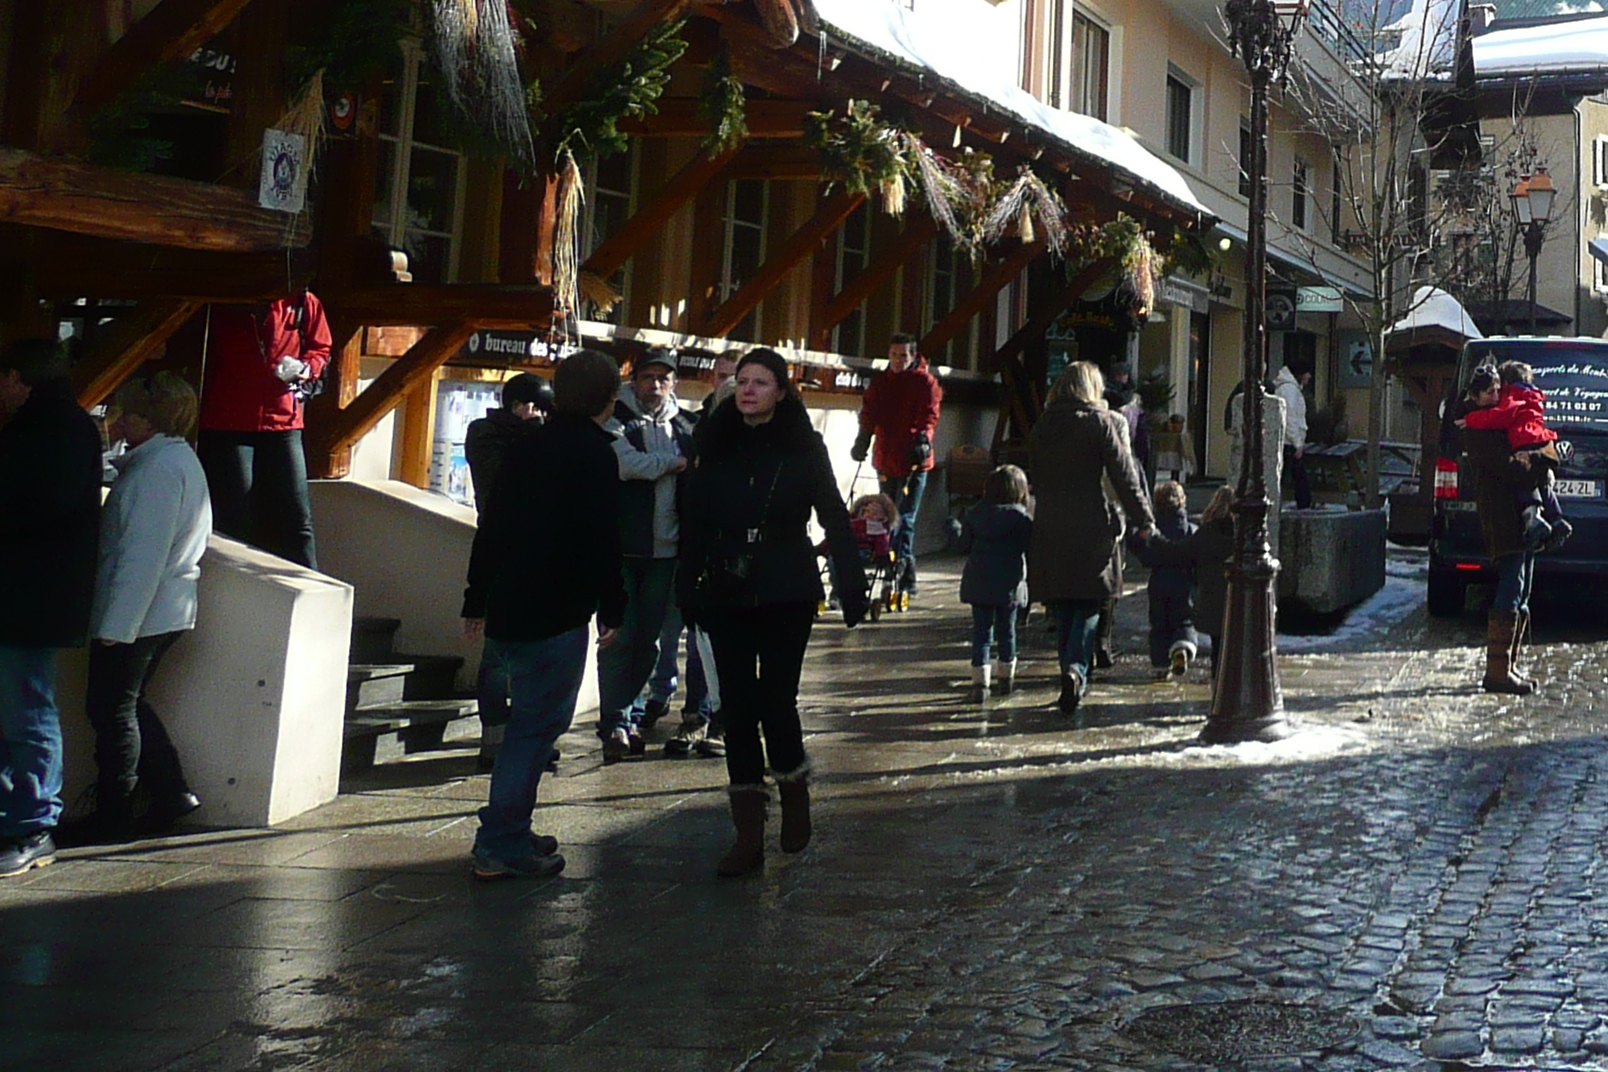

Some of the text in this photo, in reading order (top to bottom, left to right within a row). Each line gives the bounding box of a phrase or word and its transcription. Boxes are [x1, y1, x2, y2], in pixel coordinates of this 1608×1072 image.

[485, 333, 526, 359] bureau
[529, 336, 548, 357] des
[1552, 481, 1592, 495] 424-ZL
